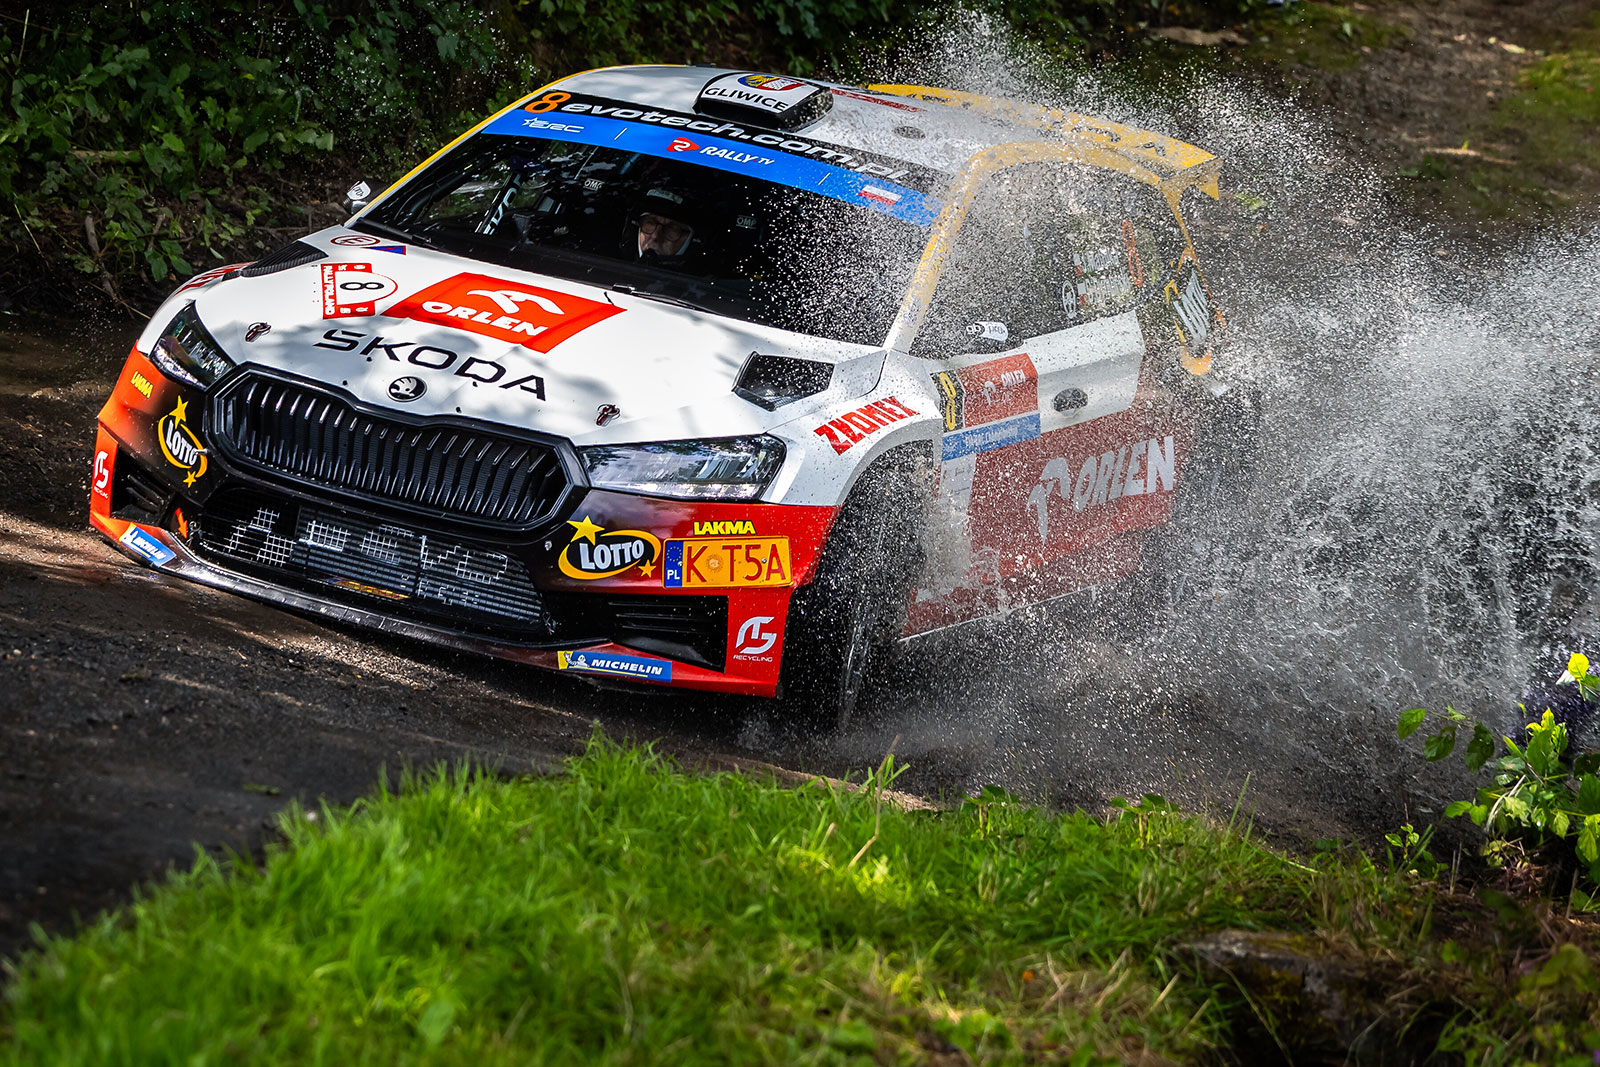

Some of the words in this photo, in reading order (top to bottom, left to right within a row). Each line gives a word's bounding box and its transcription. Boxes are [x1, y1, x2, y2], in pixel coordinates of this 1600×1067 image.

[704, 87, 789, 112] GLIWICE
[524, 91, 571, 113] 8
[561, 103, 910, 180] evotech.com.pl
[736, 216, 757, 227] OMP
[339, 281, 385, 291] 8
[422, 301, 549, 337] ORLEN
[130, 371, 154, 399] LAKMA
[938, 372, 957, 431] 8
[165, 420, 199, 466] LOTTO
[1072, 436, 1175, 513] ORLEN
[693, 520, 757, 536] LAKMA
[578, 539, 645, 571] LOTTO
[666, 569, 681, 580] PL
[686, 546, 708, 583] K
[722, 543, 787, 582] T5A
[591, 658, 664, 676] MICHELIN
[732, 654, 774, 663] RECYCLING
